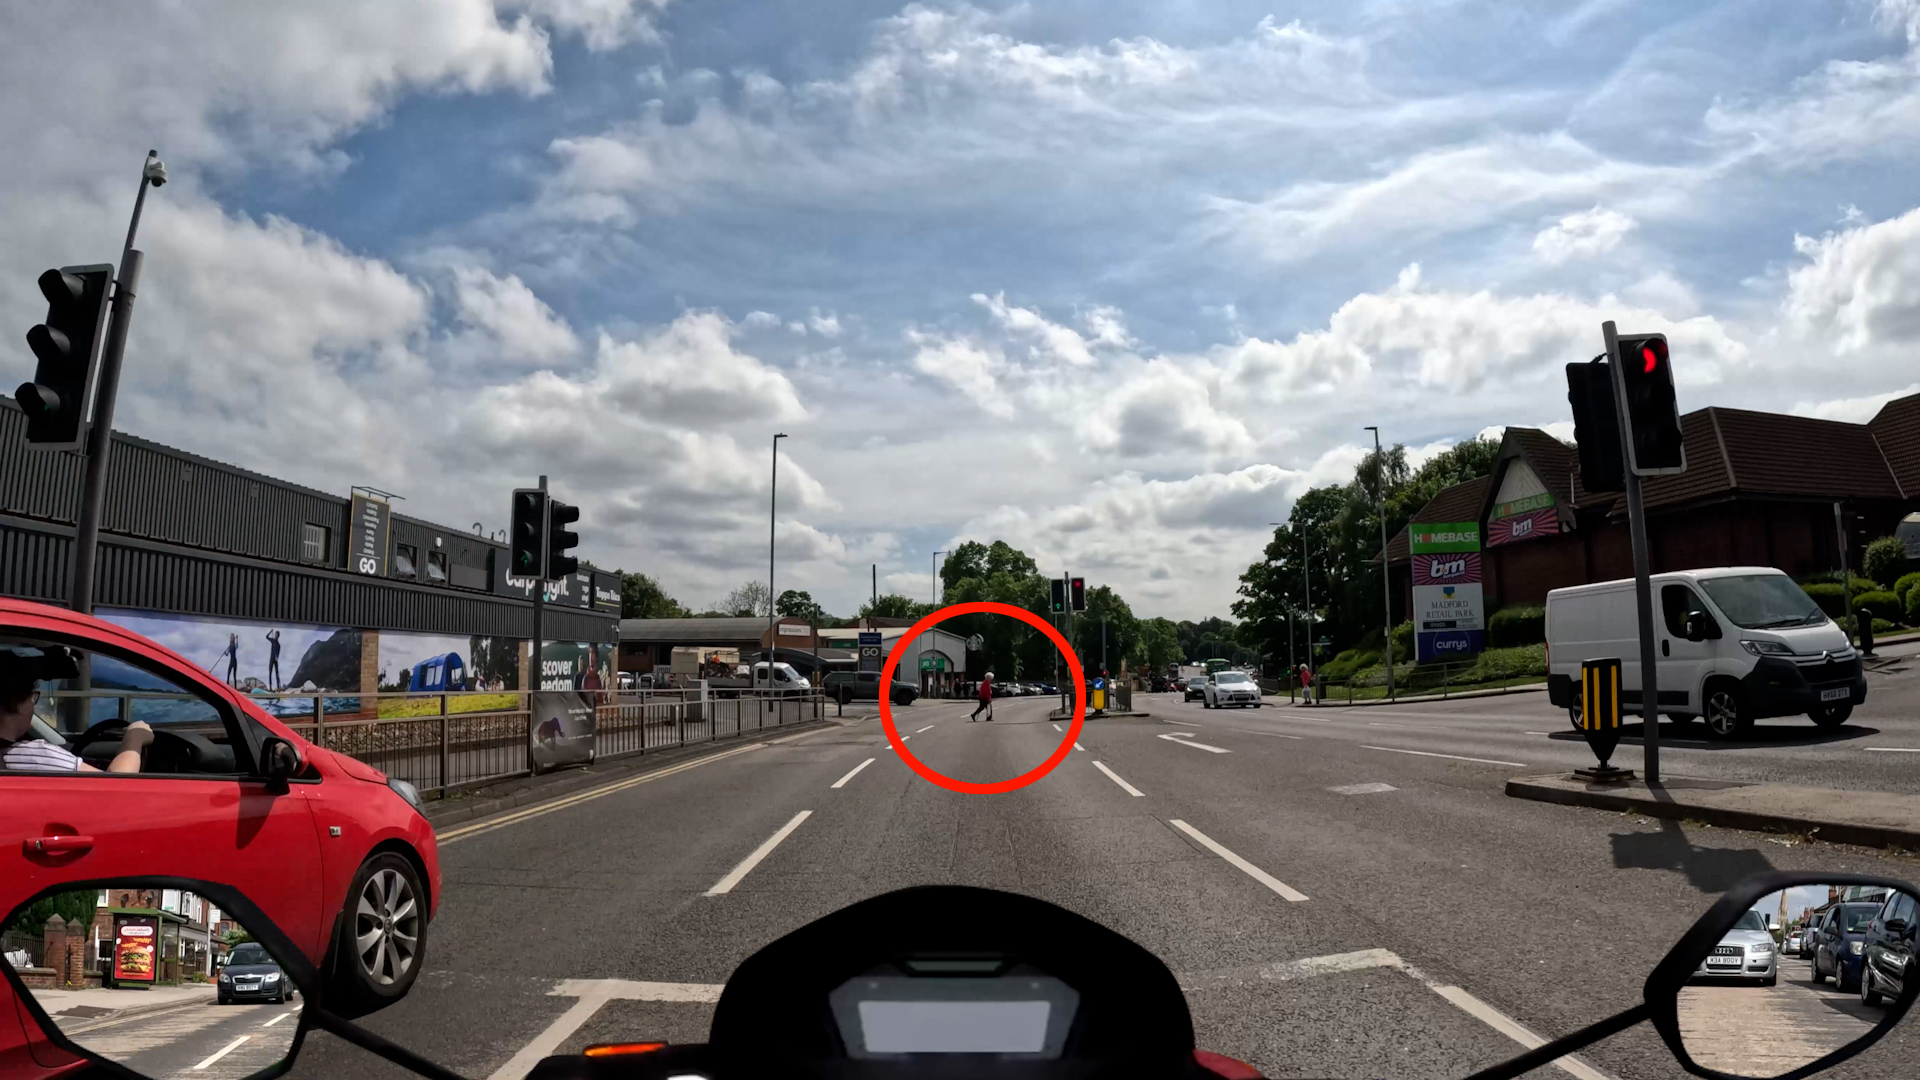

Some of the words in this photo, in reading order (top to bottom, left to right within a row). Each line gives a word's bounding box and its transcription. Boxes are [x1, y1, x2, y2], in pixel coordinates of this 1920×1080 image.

[1413, 531, 1478, 544] HOMEBASE
[360, 557, 376, 574] GO
[610, 589, 620, 601] Tiles
[1431, 600, 1468, 609] MADFORD
[1426, 611, 1452, 619] RETAIL
[1455, 609, 1474, 618] PARK
[1436, 640, 1467, 651] currys
[862, 647, 879, 657] GO
[541, 660, 573, 676] scover
[540, 677, 573, 691] eedom
